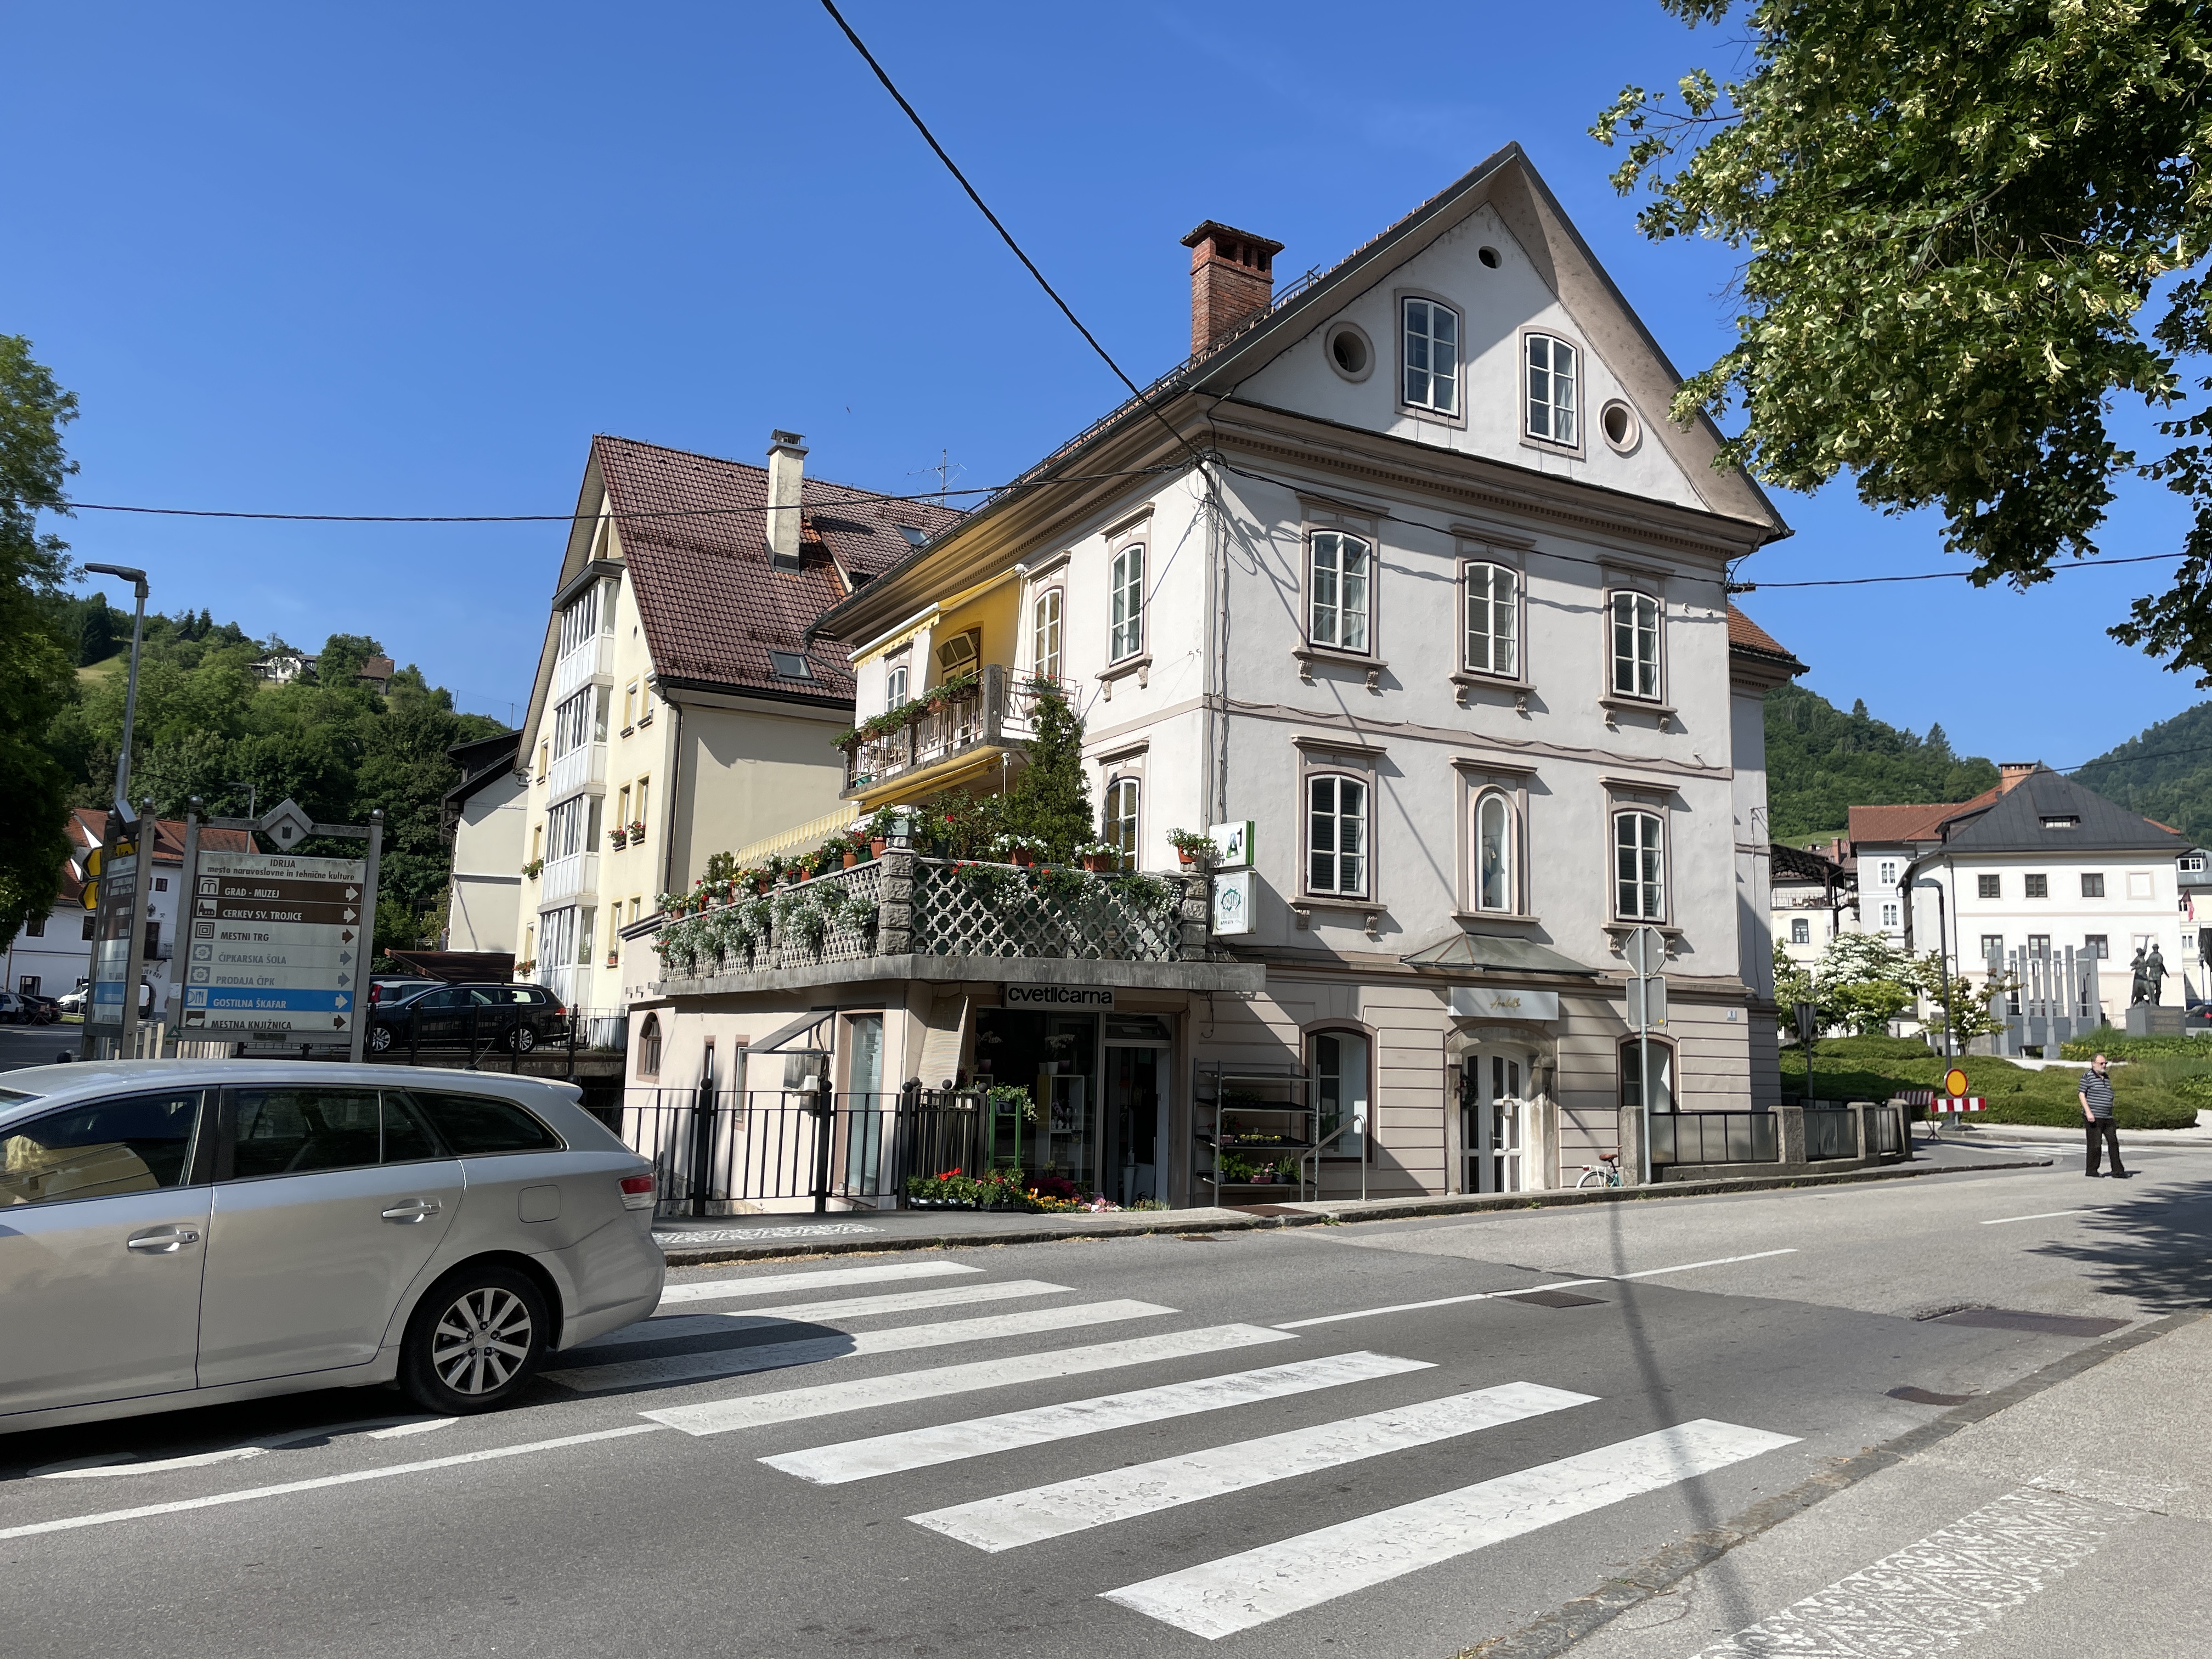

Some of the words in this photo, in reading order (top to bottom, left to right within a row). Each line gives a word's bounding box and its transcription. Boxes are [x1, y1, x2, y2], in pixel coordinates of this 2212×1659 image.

[1226, 828, 1243, 859] A1
[270, 859, 296, 867] IDRIJA
[233, 867, 284, 877] naravoslovne
[296, 870, 326, 879] tehnične
[328, 871, 354, 881] kulture
[224, 888, 247, 896] GRAD
[254, 889, 280, 898] MUZEJ
[222, 909, 254, 918] CERKEV
[255, 910, 268, 919] SV.
[270, 911, 302, 921] TROJICE
[221, 932, 251, 941] MESTNI
[253, 933, 269, 941] TRG
[218, 952, 263, 963] ČIPKARSKA
[266, 953, 286, 964] ŠOLA
[216, 976, 254, 985] PRODAJA
[256, 975, 275, 985] ČIPK
[213, 998, 253, 1007] GOSTILNA
[256, 997, 286, 1009] ŠKAFAR
[211, 1020, 245, 1029] MESTNA
[248, 1019, 292, 1030] KNJIŽNICA
